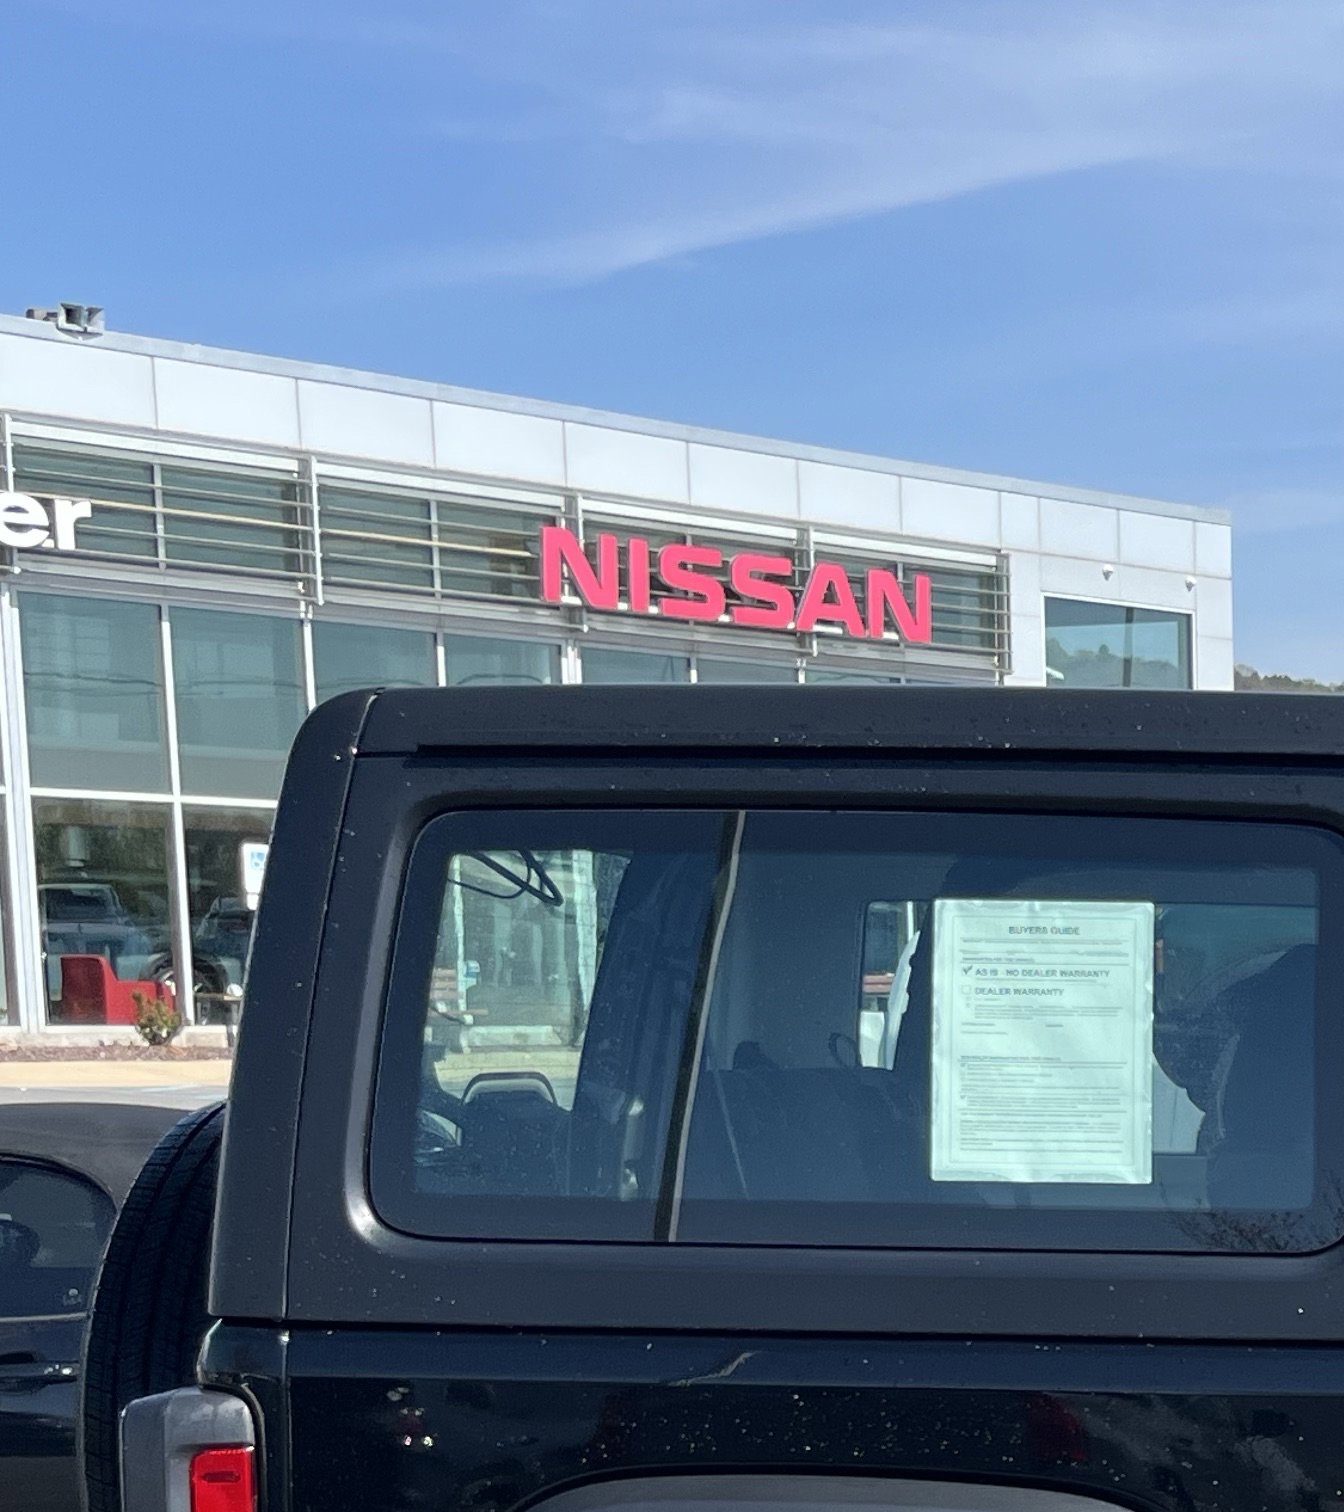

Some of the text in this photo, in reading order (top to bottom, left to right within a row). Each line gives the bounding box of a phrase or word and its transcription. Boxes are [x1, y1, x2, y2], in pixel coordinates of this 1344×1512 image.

[540, 525, 932, 644] NISSAN
[1008, 926, 1080, 935] BUYERS GUIDE
[975, 968, 1111, 978] AS IS NO DEALER WARRANTY
[975, 987, 1065, 997] DEALER WARRANTY
